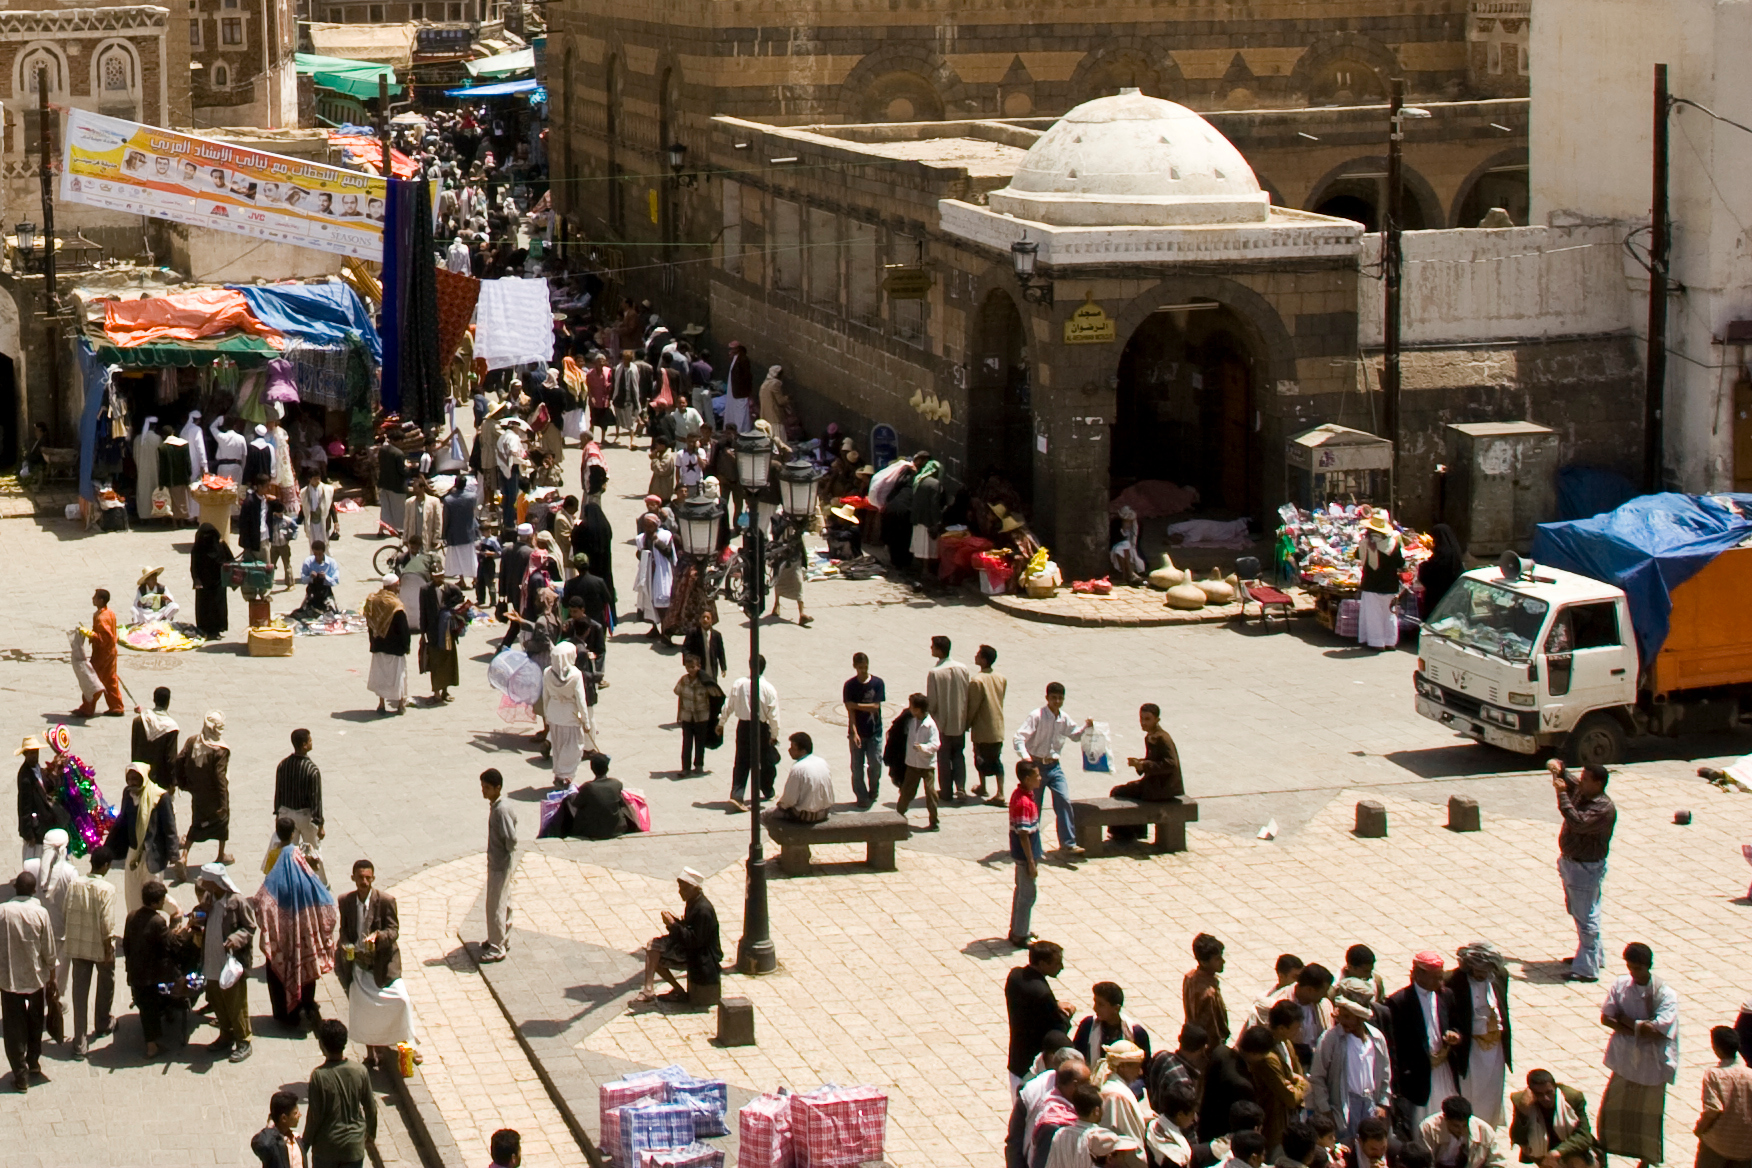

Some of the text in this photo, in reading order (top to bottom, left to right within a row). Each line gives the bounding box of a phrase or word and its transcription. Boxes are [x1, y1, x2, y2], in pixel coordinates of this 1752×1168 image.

[150, 138, 190, 156] العربي
[235, 153, 268, 172] ليالي
[271, 162, 288, 173] مع
[291, 165, 339, 182] اللحظات
[248, 212, 266, 222] JVC
[331, 231, 372, 246] SEASONS
[1078, 310, 1102, 320] مسجد
[1071, 322, 1109, 334] الرضوان
